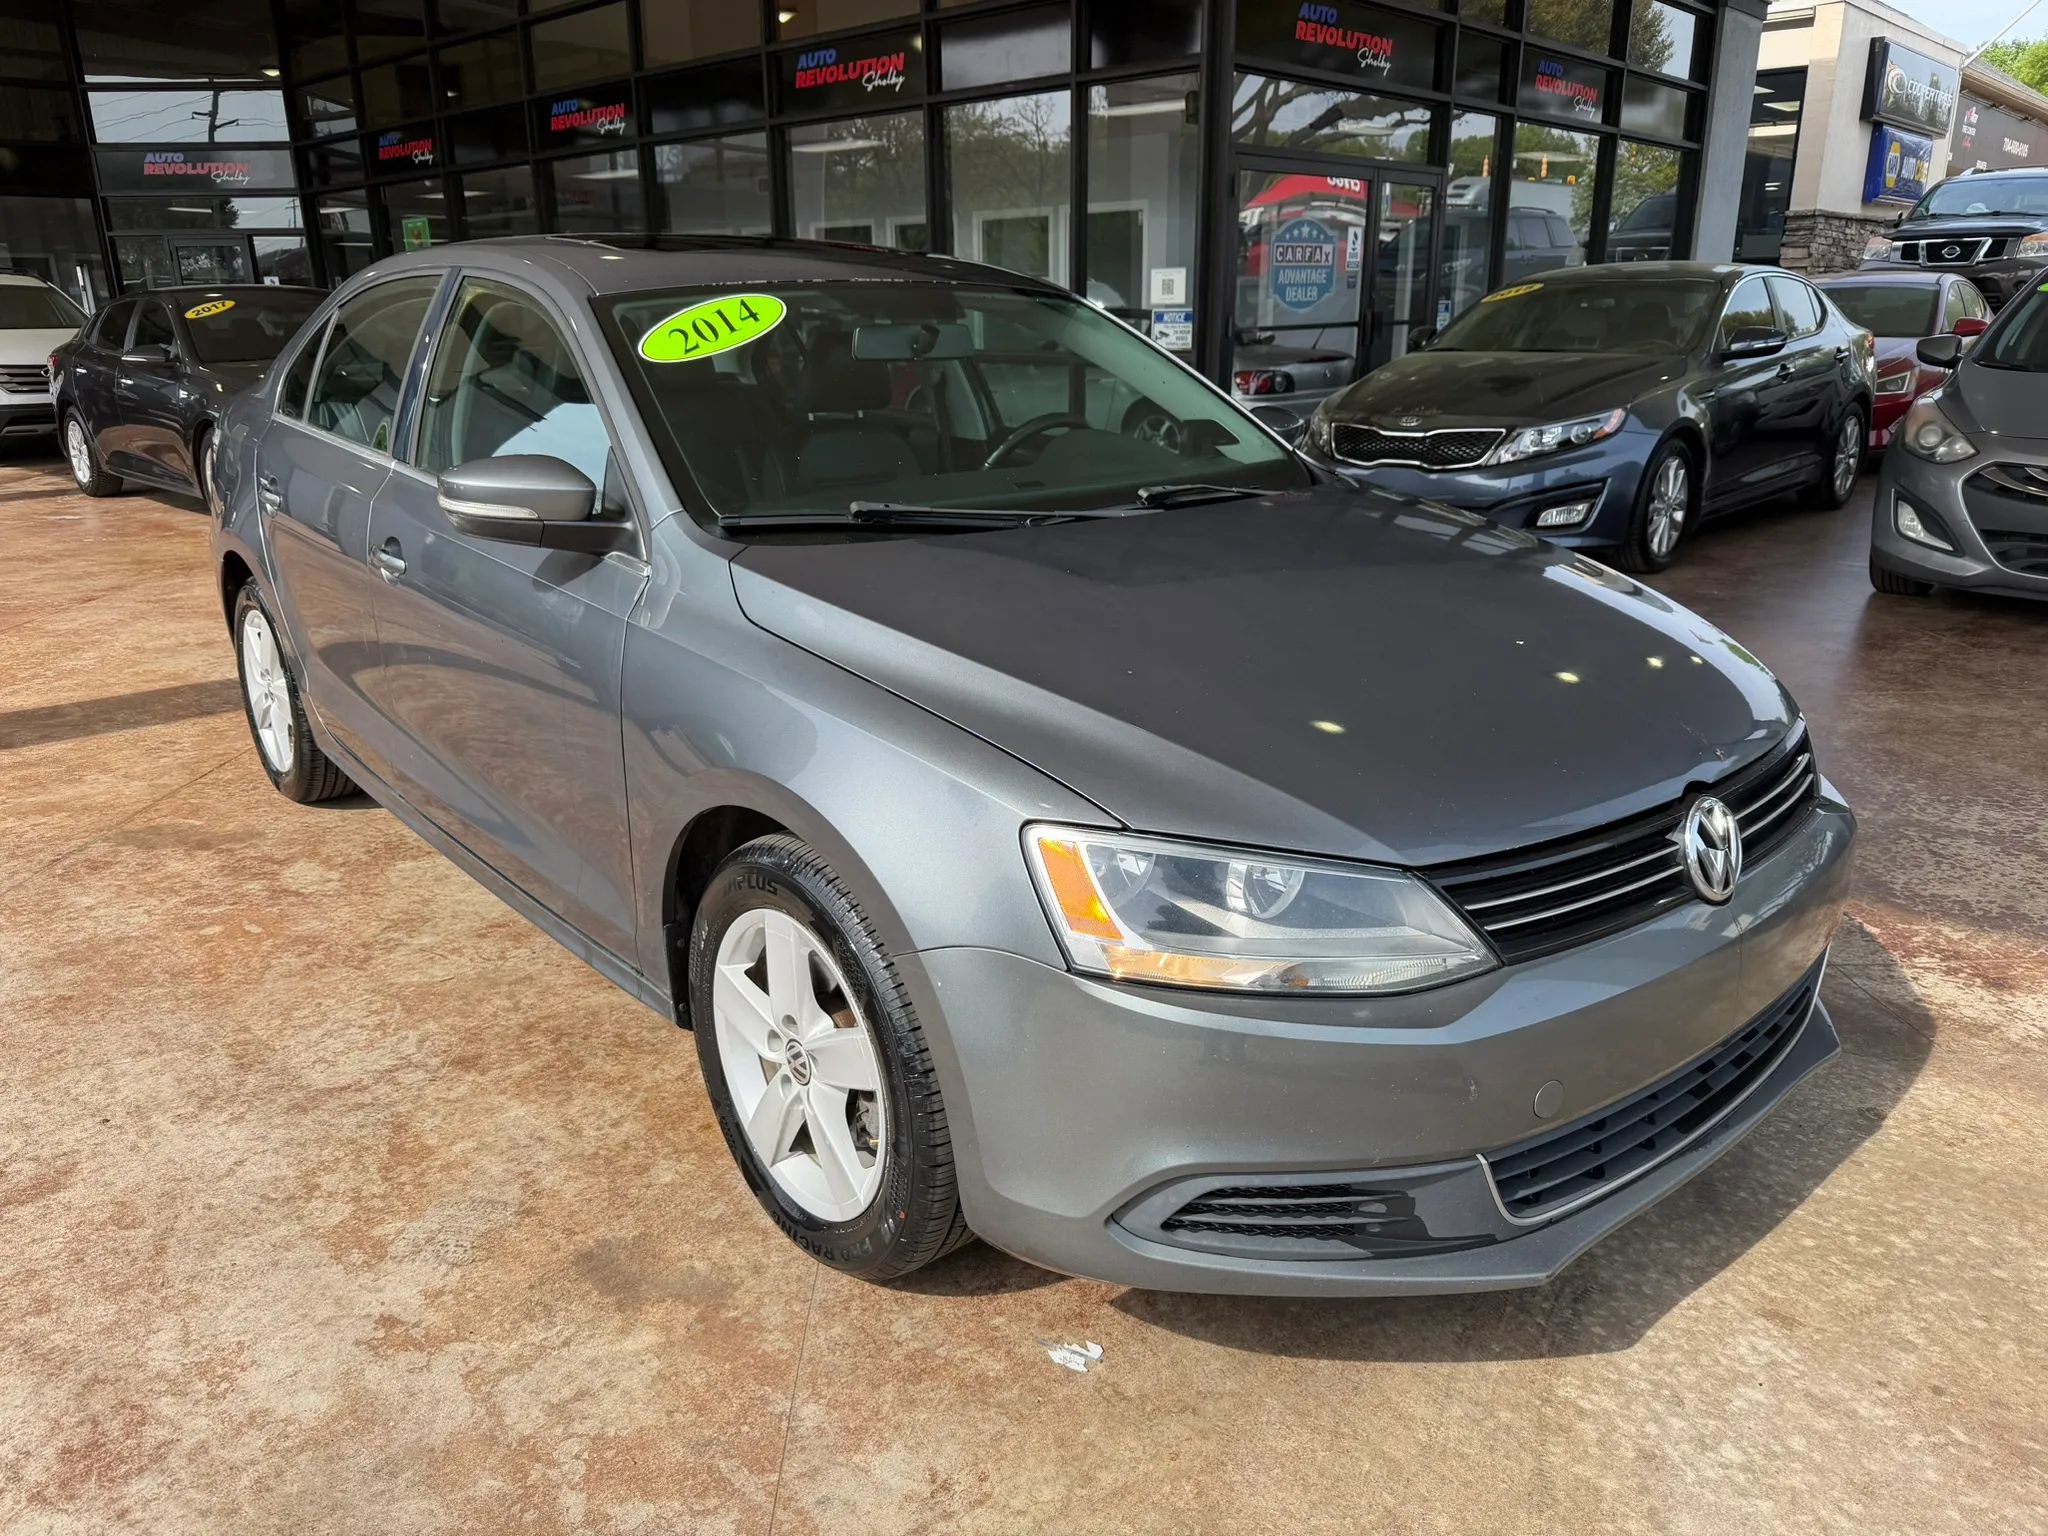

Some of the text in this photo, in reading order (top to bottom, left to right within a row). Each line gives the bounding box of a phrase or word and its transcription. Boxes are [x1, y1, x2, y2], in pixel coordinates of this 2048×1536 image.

[1299, 2, 1337, 23] AUTO
[1295, 20, 1392, 56] REVOLUTION
[797, 48, 837, 69] AUTO
[1357, 47, 1392, 76] Shelby
[1538, 60, 1563, 77] AUTO
[795, 52, 904, 88] REVOLUTION
[862, 66, 905, 92] Shelby
[1535, 74, 1598, 102] REVOLUTION
[551, 100, 578, 115] AUTO
[551, 103, 625, 131] REVOLUTION
[1573, 95, 1595, 119] Shelby
[597, 114, 626, 135] Shelby
[378, 134, 400, 146] AUTO
[378, 139, 432, 160] REVOLUTION
[144, 152, 184, 163] AUTO
[412, 148, 433, 165] Shelby
[144, 163, 249, 175] REVOLUTION
[211, 170, 250, 184] Shelby
[1276, 245, 1332, 264] CARFAX
[1278, 268, 1327, 285] ADVANTAGE
[1285, 286, 1318, 302] DEALER
[192, 302, 225, 316] 2017
[1163, 312, 1186, 322] NOTICE
[668, 299, 761, 355] 2014
[772, 1210, 835, 1261] RACING
